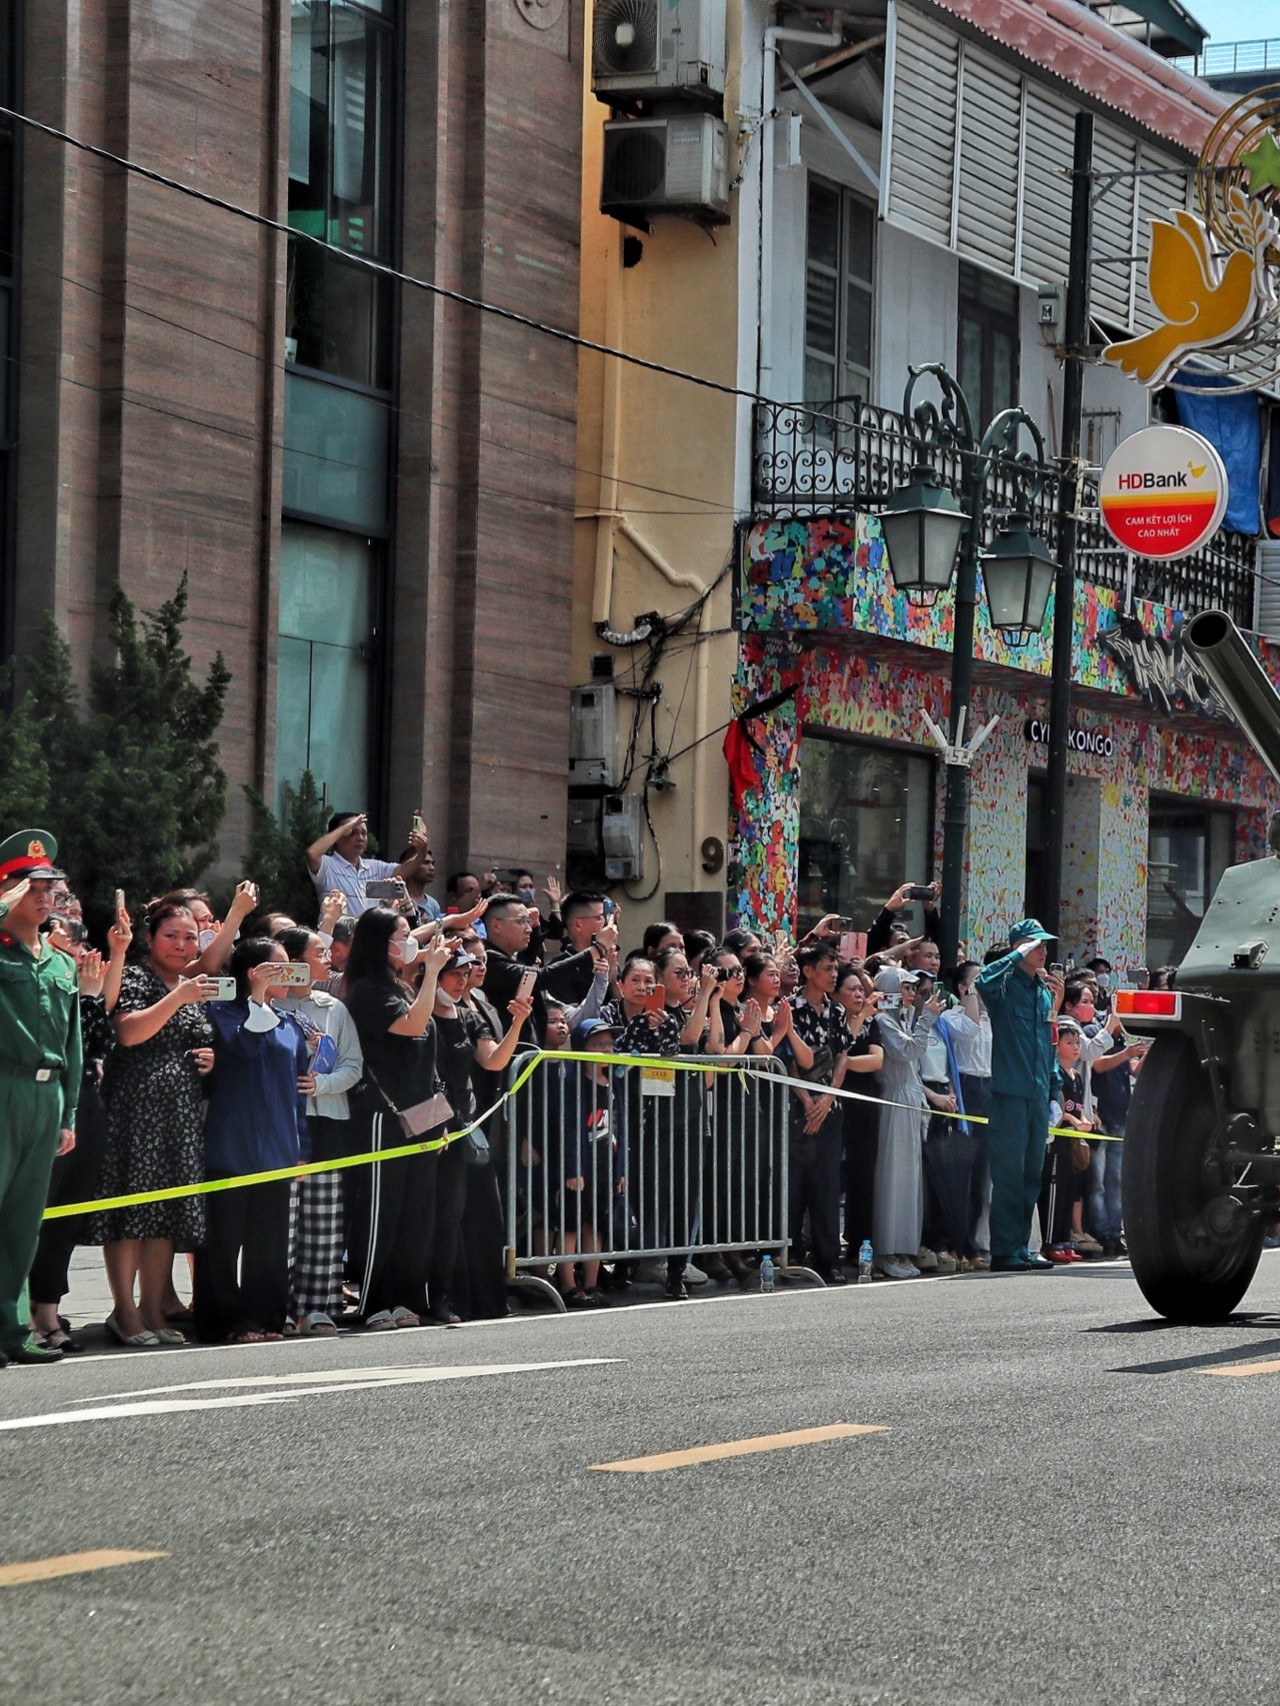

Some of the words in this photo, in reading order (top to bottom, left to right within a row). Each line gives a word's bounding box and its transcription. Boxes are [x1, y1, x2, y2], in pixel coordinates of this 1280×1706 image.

[1118, 471, 1187, 490] HDBank
[1125, 517, 1143, 526] CAM
[1178, 513, 1192, 524] ÍCH
[1137, 529, 1155, 538] CAO
[1068, 729, 1113, 756] KONGO
[702, 836, 724, 875] 9
